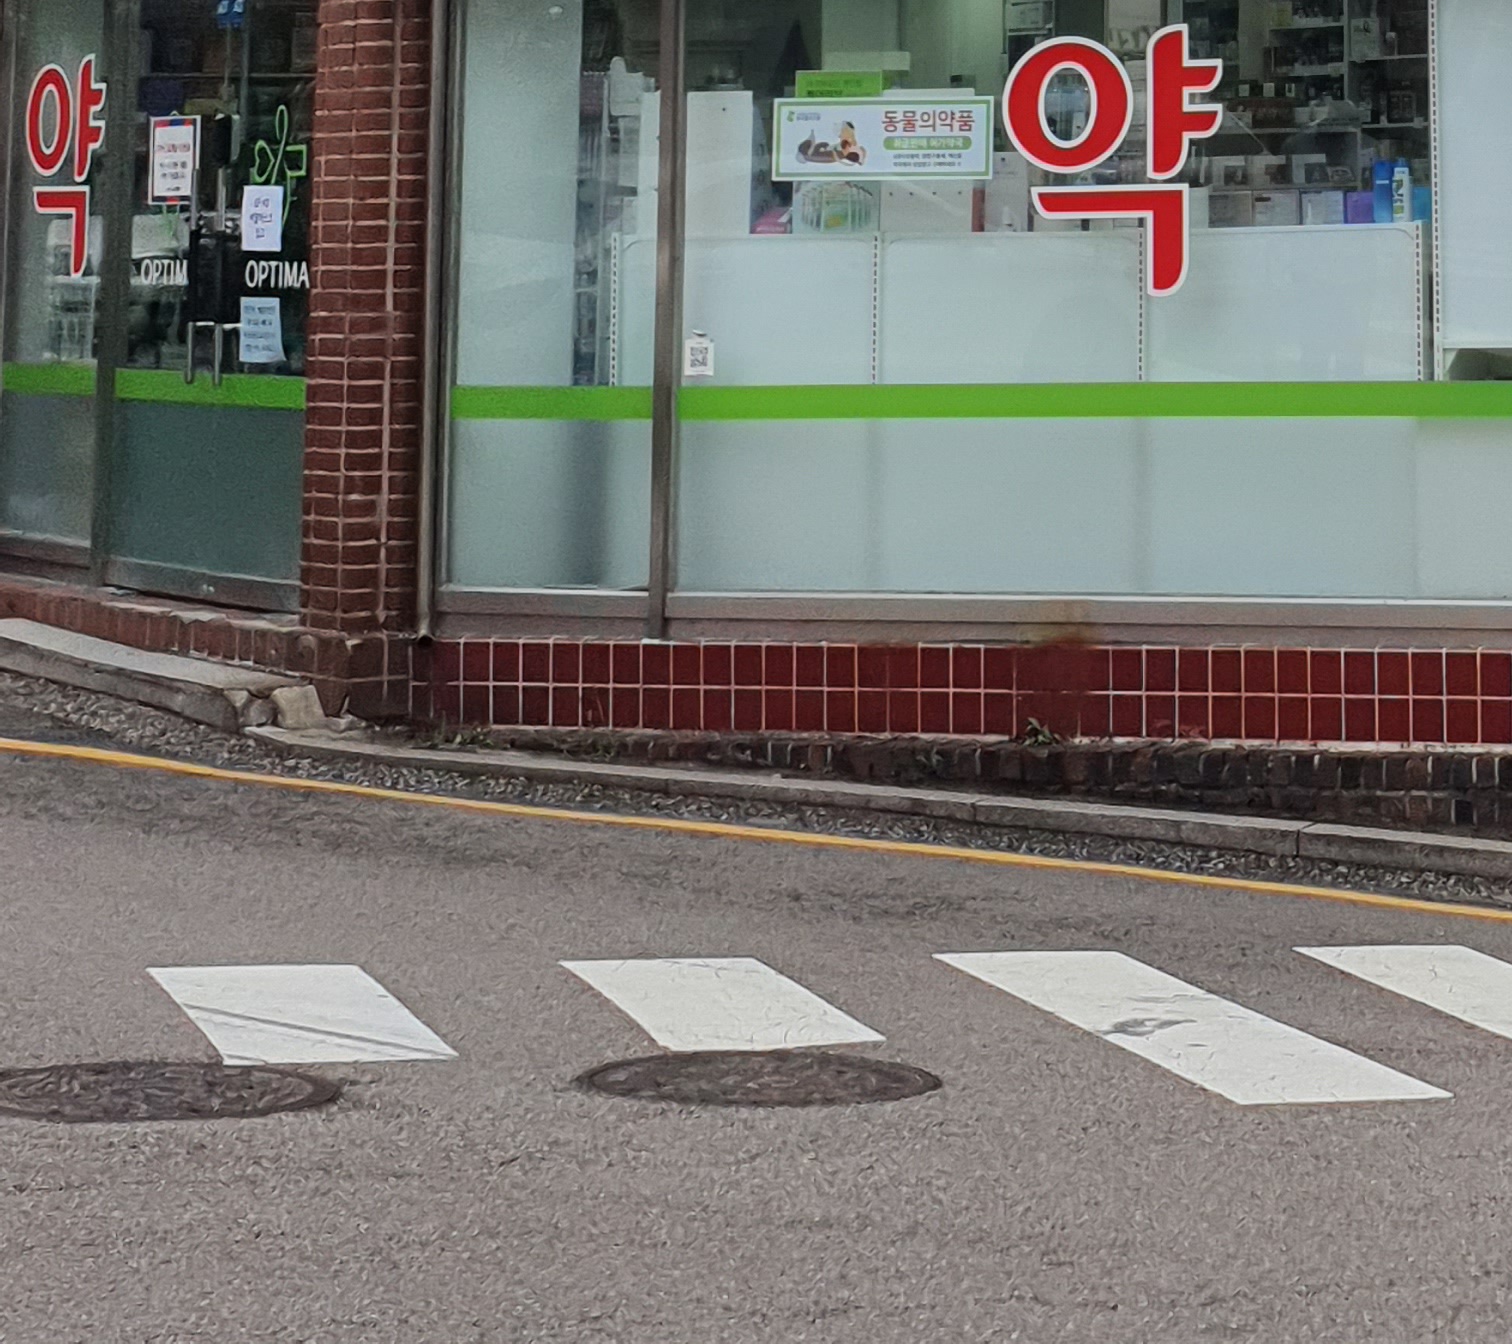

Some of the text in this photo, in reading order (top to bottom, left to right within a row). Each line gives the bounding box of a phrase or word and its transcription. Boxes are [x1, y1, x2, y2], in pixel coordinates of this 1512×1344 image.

[881, 109, 976, 133] 동물의약품
[26, 54, 107, 279] 약
[1002, 23, 1222, 297] 약
[140, 258, 188, 285] OPTIM
[245, 259, 310, 289] OPTIMA
